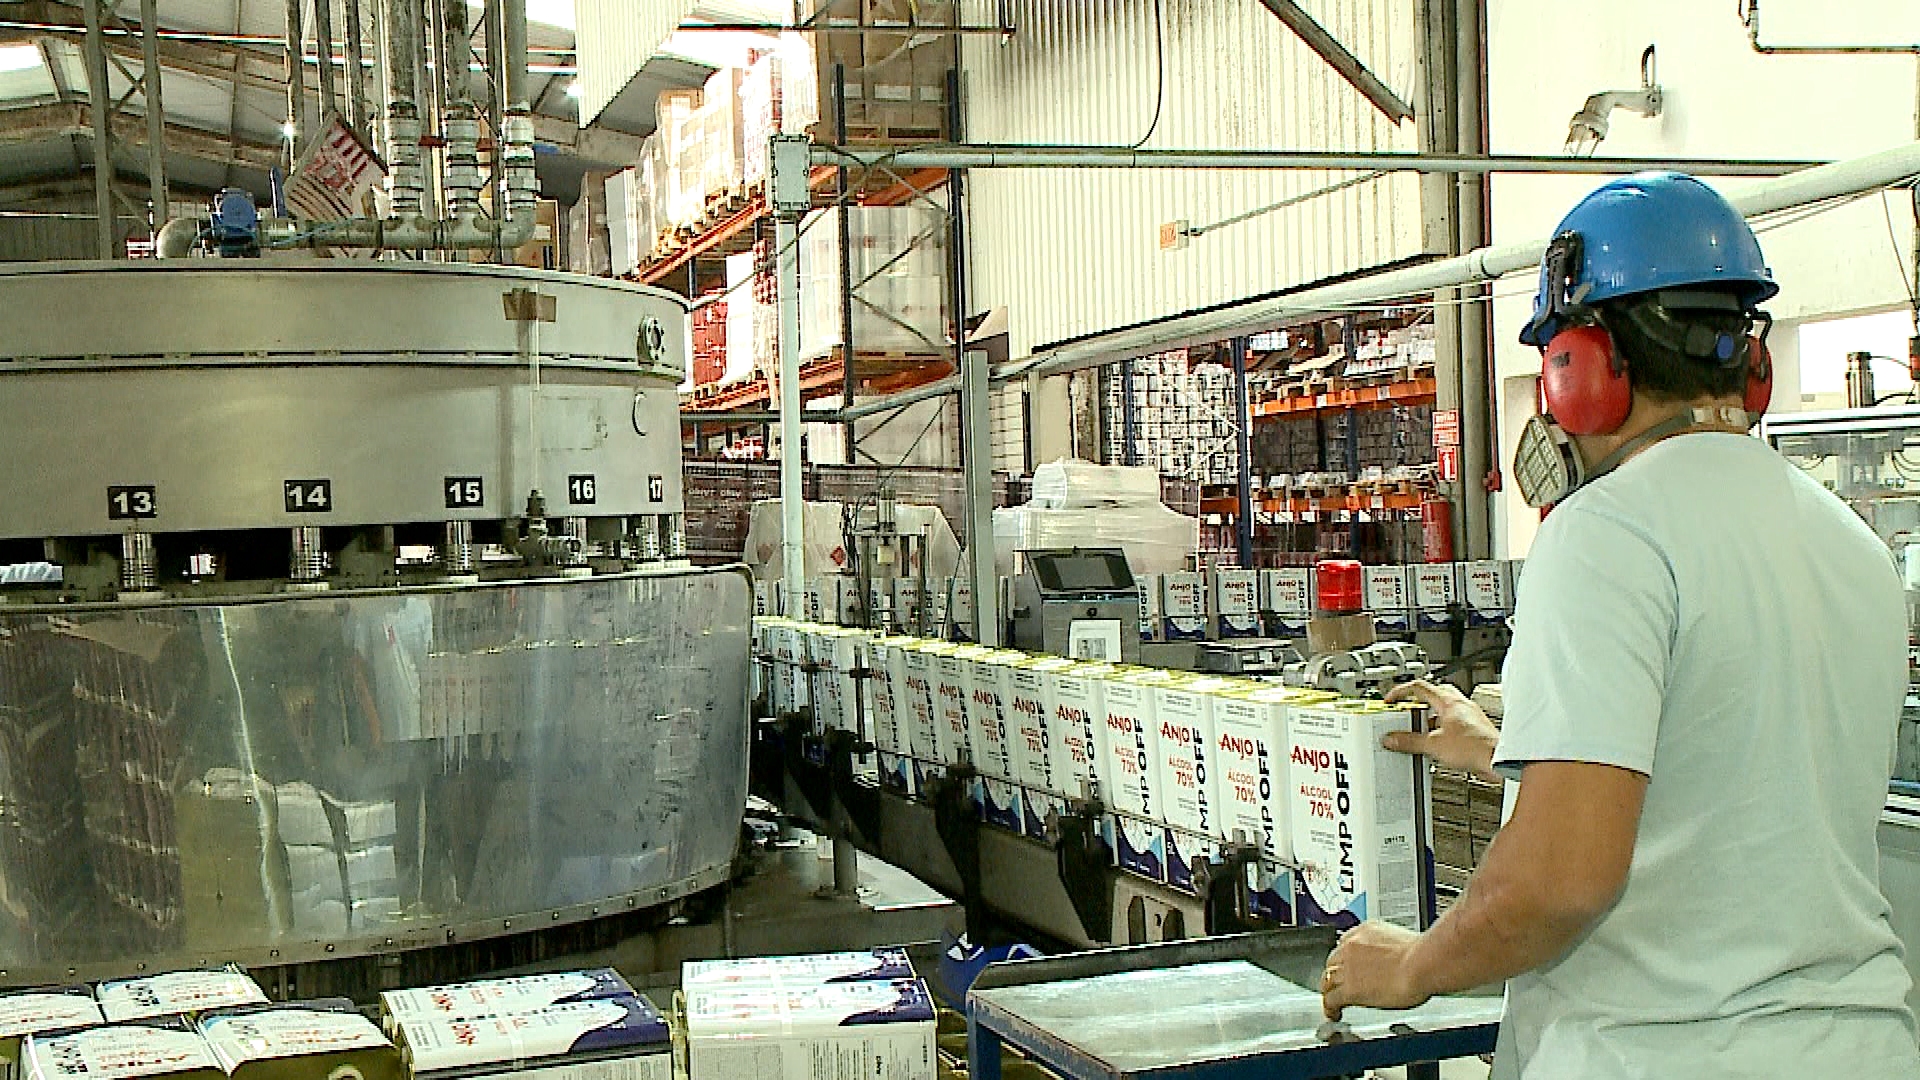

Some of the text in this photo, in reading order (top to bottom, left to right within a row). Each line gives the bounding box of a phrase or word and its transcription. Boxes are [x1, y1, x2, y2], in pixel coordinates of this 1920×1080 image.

[288, 485, 327, 507] 14
[449, 482, 481, 503] 15
[571, 480, 594, 499] 16
[648, 477, 663, 498] 17
[112, 491, 152, 514] 13
[1012, 696, 1036, 718] ANJO
[1055, 703, 1081, 727] ANJO
[1036, 699, 1049, 749] OFF
[1081, 708, 1095, 761] OFF
[1106, 712, 1132, 737] ANJO
[1159, 720, 1190, 748] ANJO
[1133, 717, 1147, 771] OFF
[1218, 733, 1254, 761] ANJO
[1121, 759, 1138, 776] 70%
[1191, 728, 1206, 785] OFF
[1290, 745, 1331, 773] ANJO
[1175, 770, 1195, 789] 70%
[1256, 738, 1272, 802] OFF
[1234, 785, 1257, 805] 70%
[1300, 782, 1333, 801] ÁLCOOL
[1309, 800, 1334, 820] 70%
[1334, 750, 1354, 894] LIMP OFF
